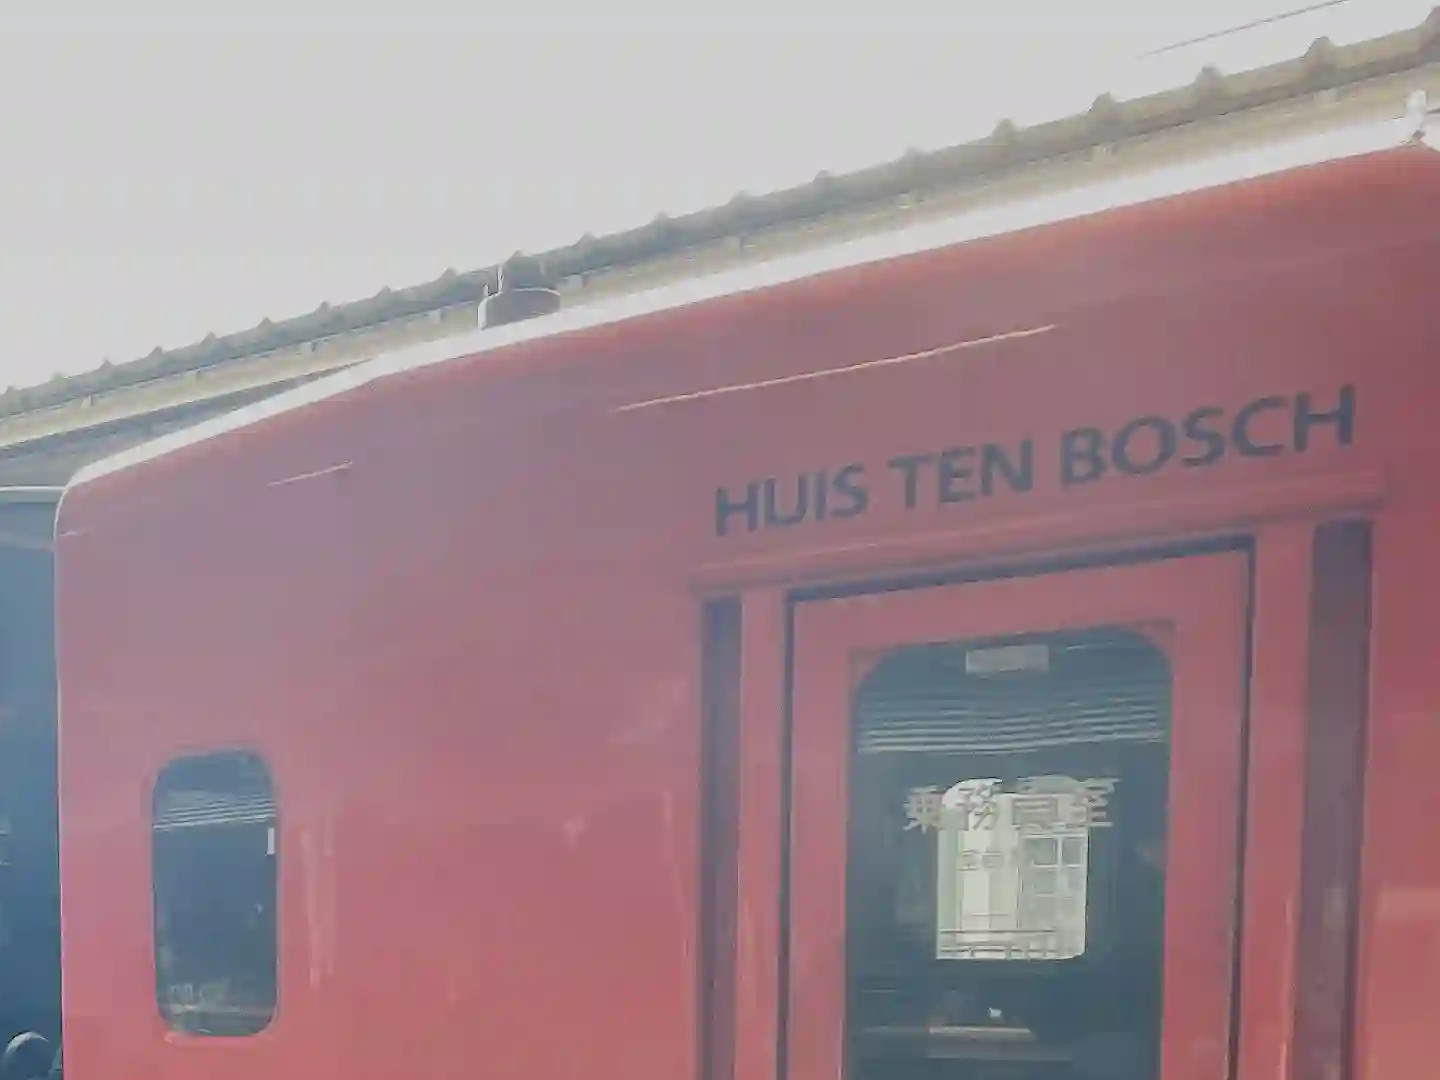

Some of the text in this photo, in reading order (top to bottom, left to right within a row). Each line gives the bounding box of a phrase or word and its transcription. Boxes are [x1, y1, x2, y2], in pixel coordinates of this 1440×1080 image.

[714, 383, 1356, 537] HUIS TEN BOSCH
